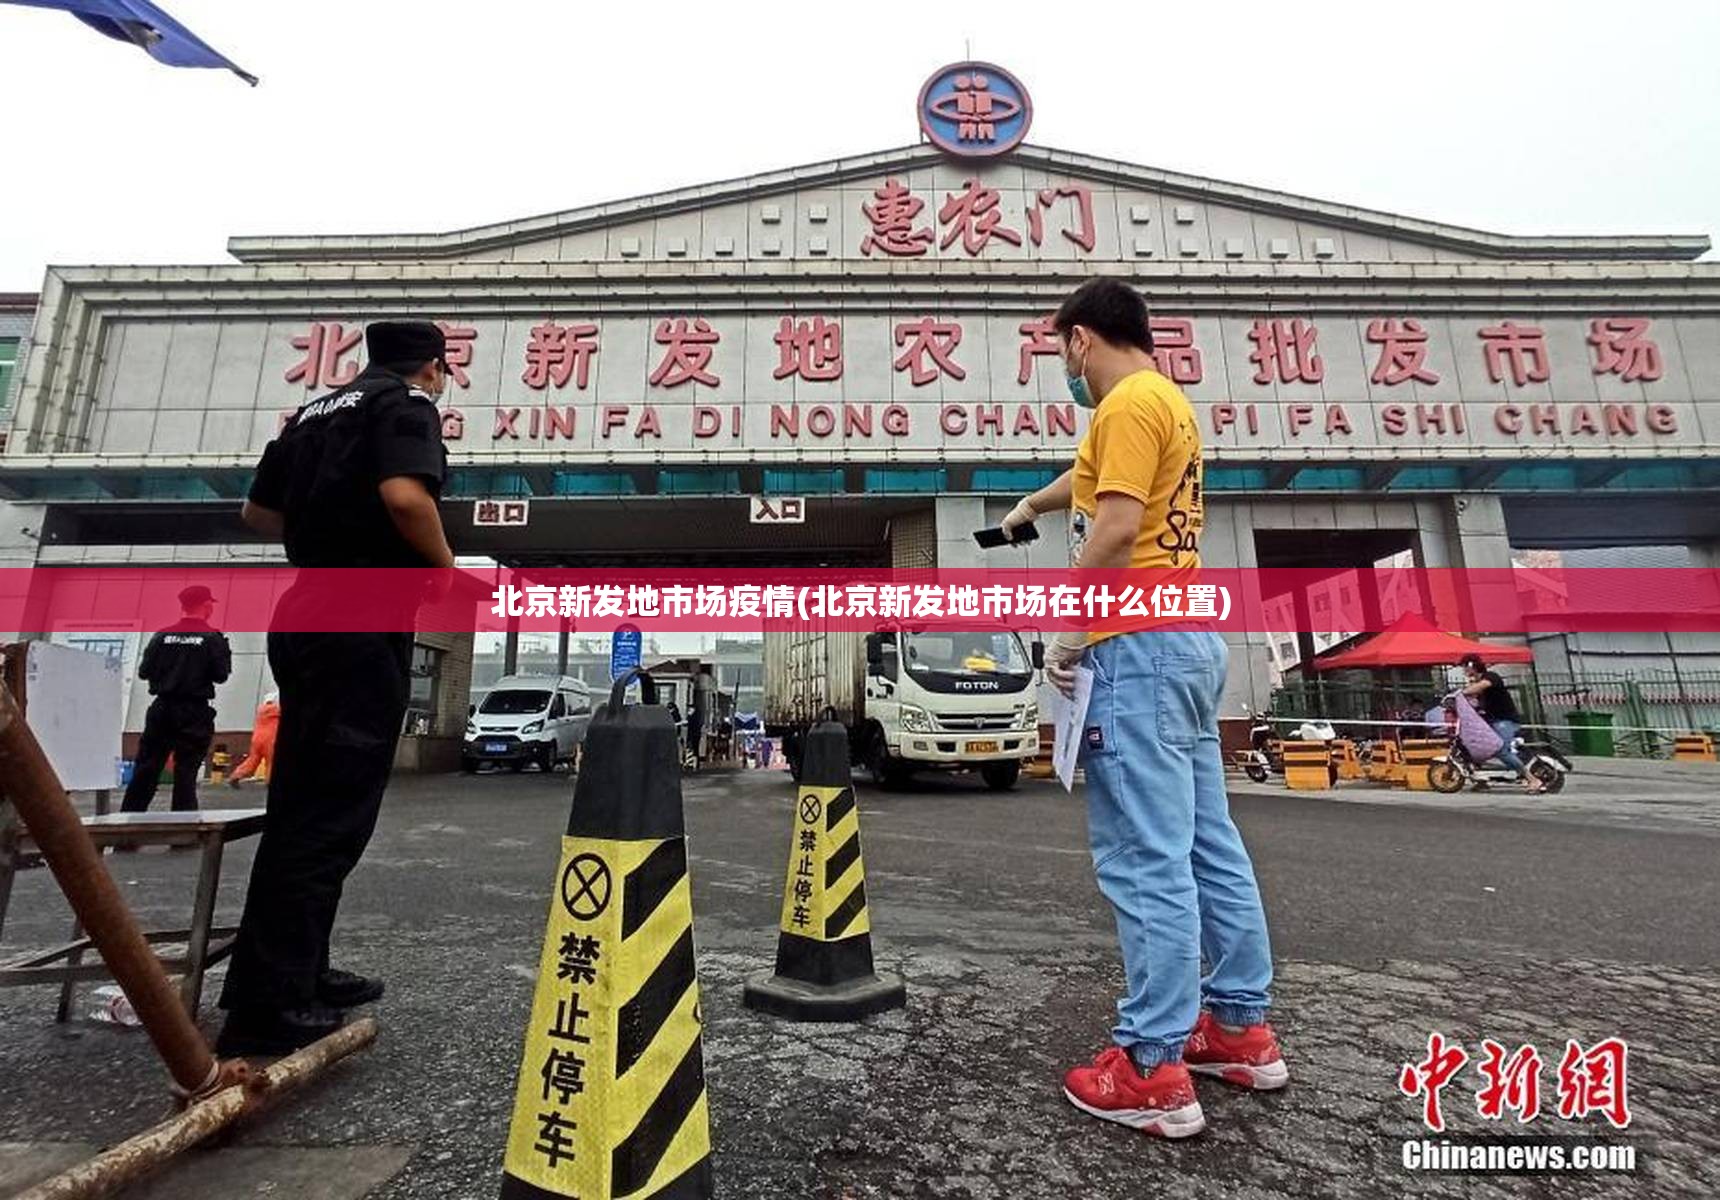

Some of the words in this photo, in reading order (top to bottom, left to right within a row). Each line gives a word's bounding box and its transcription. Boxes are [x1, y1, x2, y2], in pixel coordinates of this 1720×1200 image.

[860, 177, 1095, 256] 惠农门
[492, 406, 577, 439] XIN
[601, 405, 662, 438] FA
[693, 405, 740, 437] DI
[770, 404, 910, 437] NONG
[940, 404, 1077, 436] CHAN
[1211, 404, 1259, 434] PI
[1288, 404, 1352, 435] FA
[1382, 404, 1465, 434] SHI
[1494, 404, 1679, 434] CHANG
[478, 502, 526, 523] 出口
[755, 500, 802, 520] 入口
[955, 681, 999, 690] FOTON
[791, 829, 818, 928] 禁止停车
[533, 932, 601, 1168] 禁止停车
